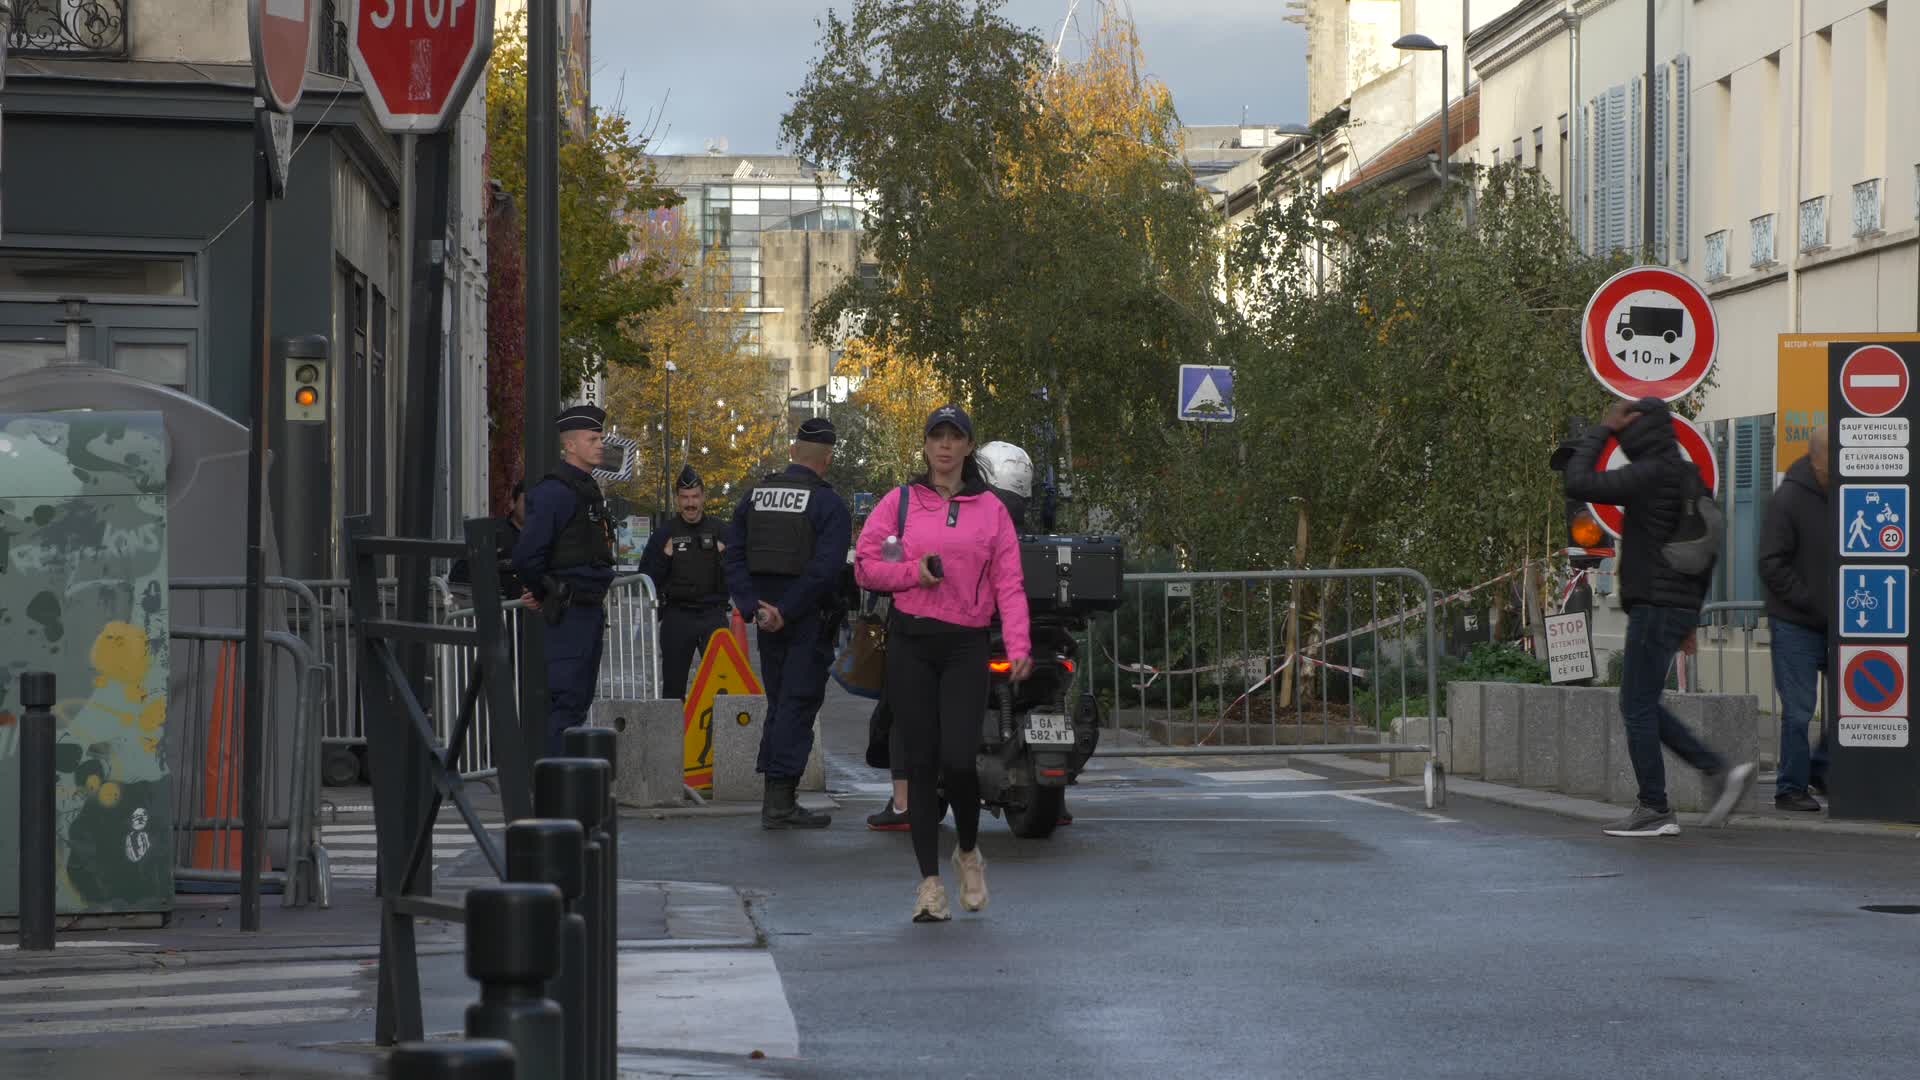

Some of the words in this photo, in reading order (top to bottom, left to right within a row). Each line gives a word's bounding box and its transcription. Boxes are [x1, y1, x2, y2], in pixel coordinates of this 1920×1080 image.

[1846, 463, 1855, 471] de
[1856, 463, 1875, 471] 6H30
[1881, 463, 1903, 471] 10H30
[753, 490, 806, 510] POLICE
[1885, 533, 1898, 542] 20
[1548, 620, 1584, 637] STOP
[1551, 638, 1586, 649] ATTENTION
[1550, 651, 1589, 663] RESPECTEZ
[1558, 667, 1567, 675] CE
[1570, 665, 1585, 673] FEU
[1862, 723, 1908, 731] VEHICULES
[1851, 733, 1897, 741] AUTORISES
